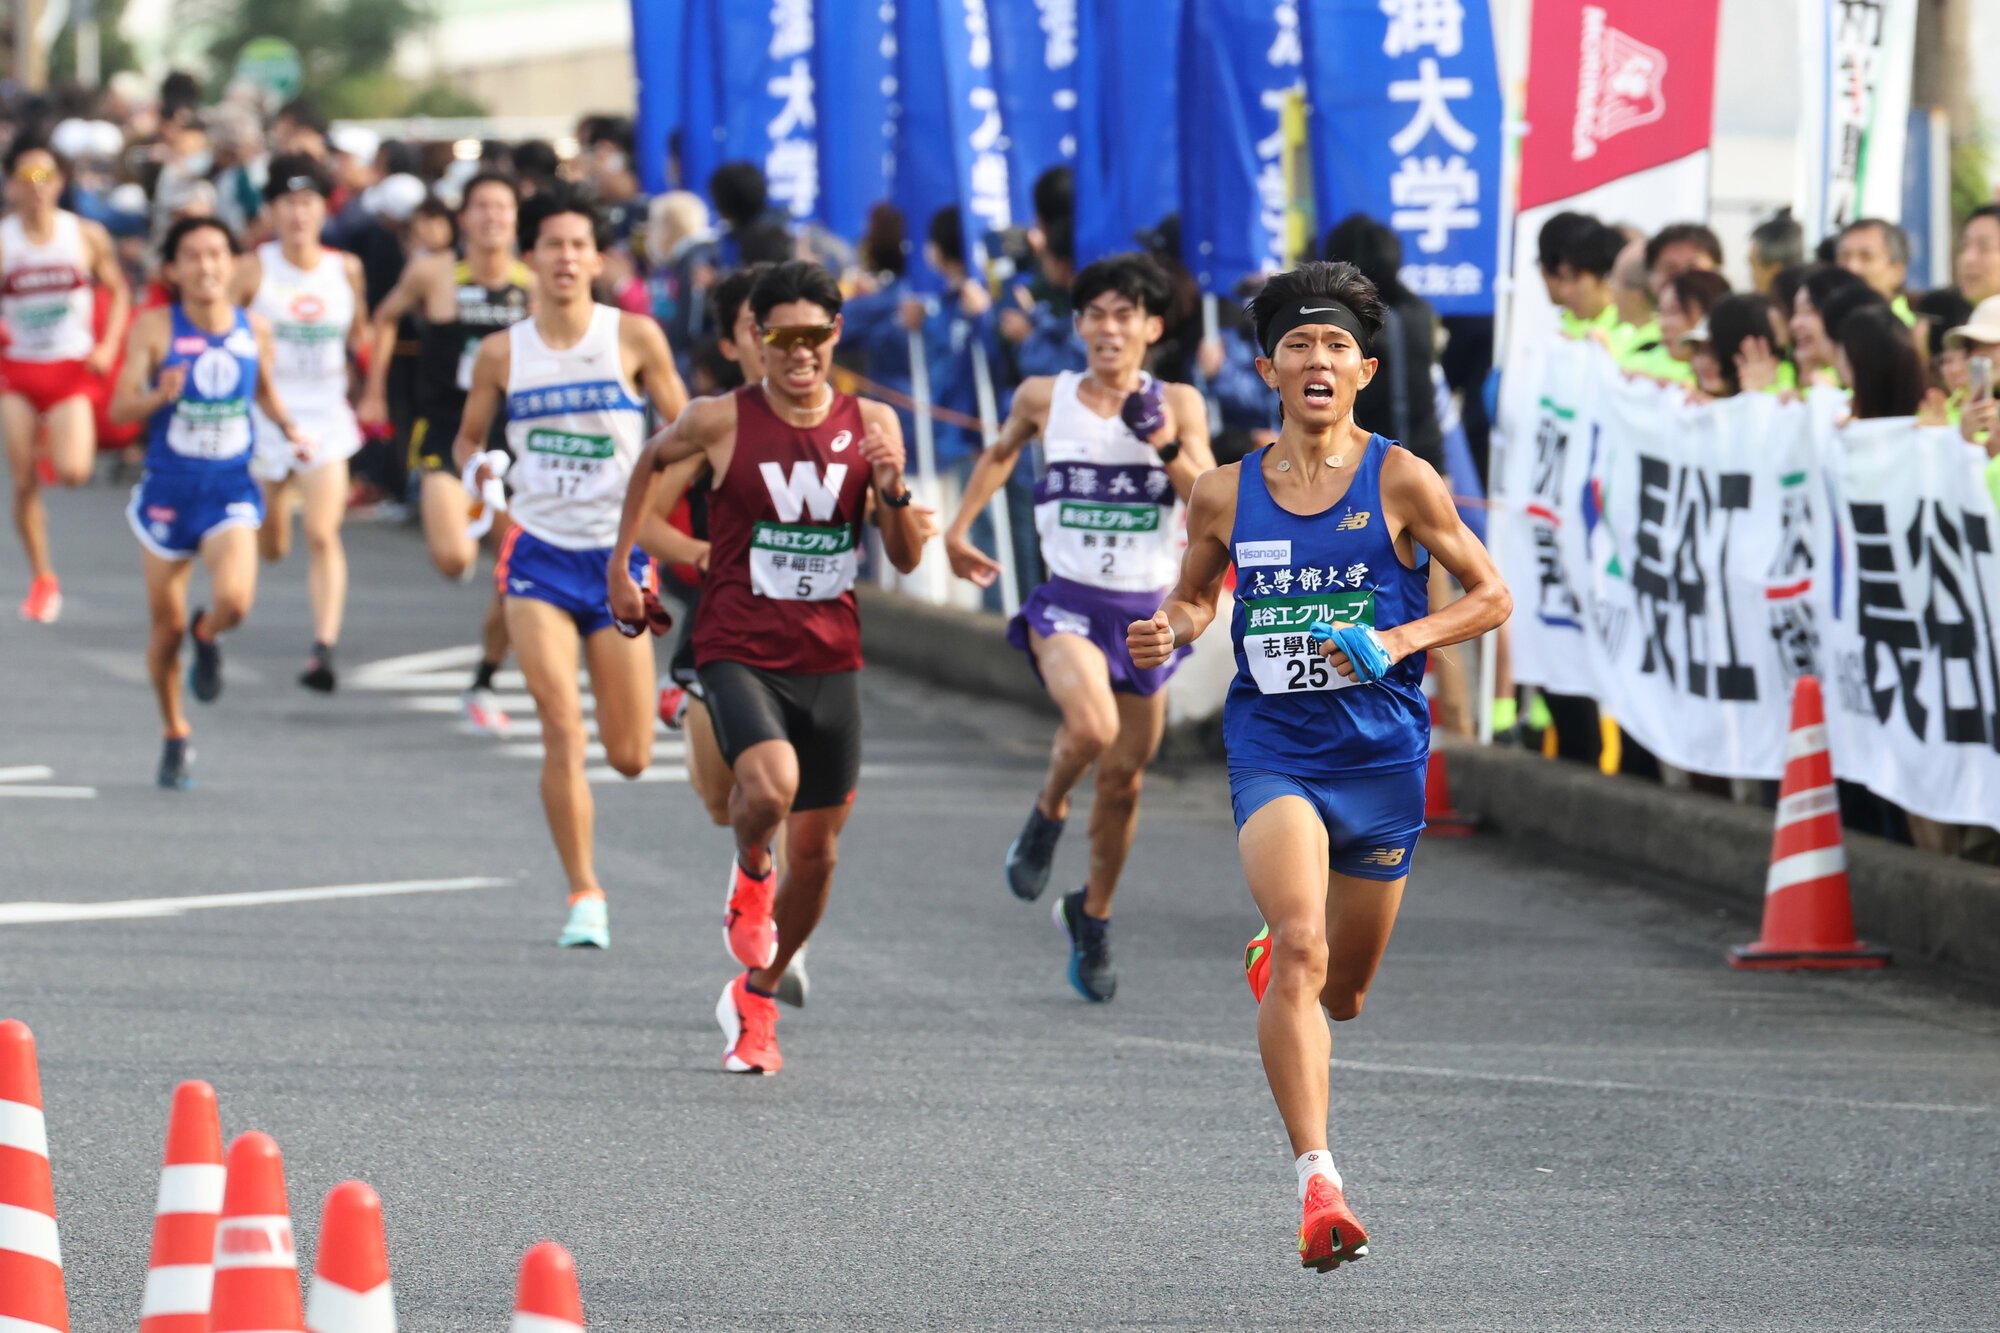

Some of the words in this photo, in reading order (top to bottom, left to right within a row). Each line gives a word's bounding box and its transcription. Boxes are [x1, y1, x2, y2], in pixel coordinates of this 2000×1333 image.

[558, 477, 581, 496] 17
[758, 461, 848, 523] W
[1101, 553, 1115, 573] 2
[1239, 548, 1288, 560] Hisanaga
[796, 576, 813, 597] 5
[1250, 600, 1369, 629] 長谷工グループ
[1286, 658, 1329, 690] 25
